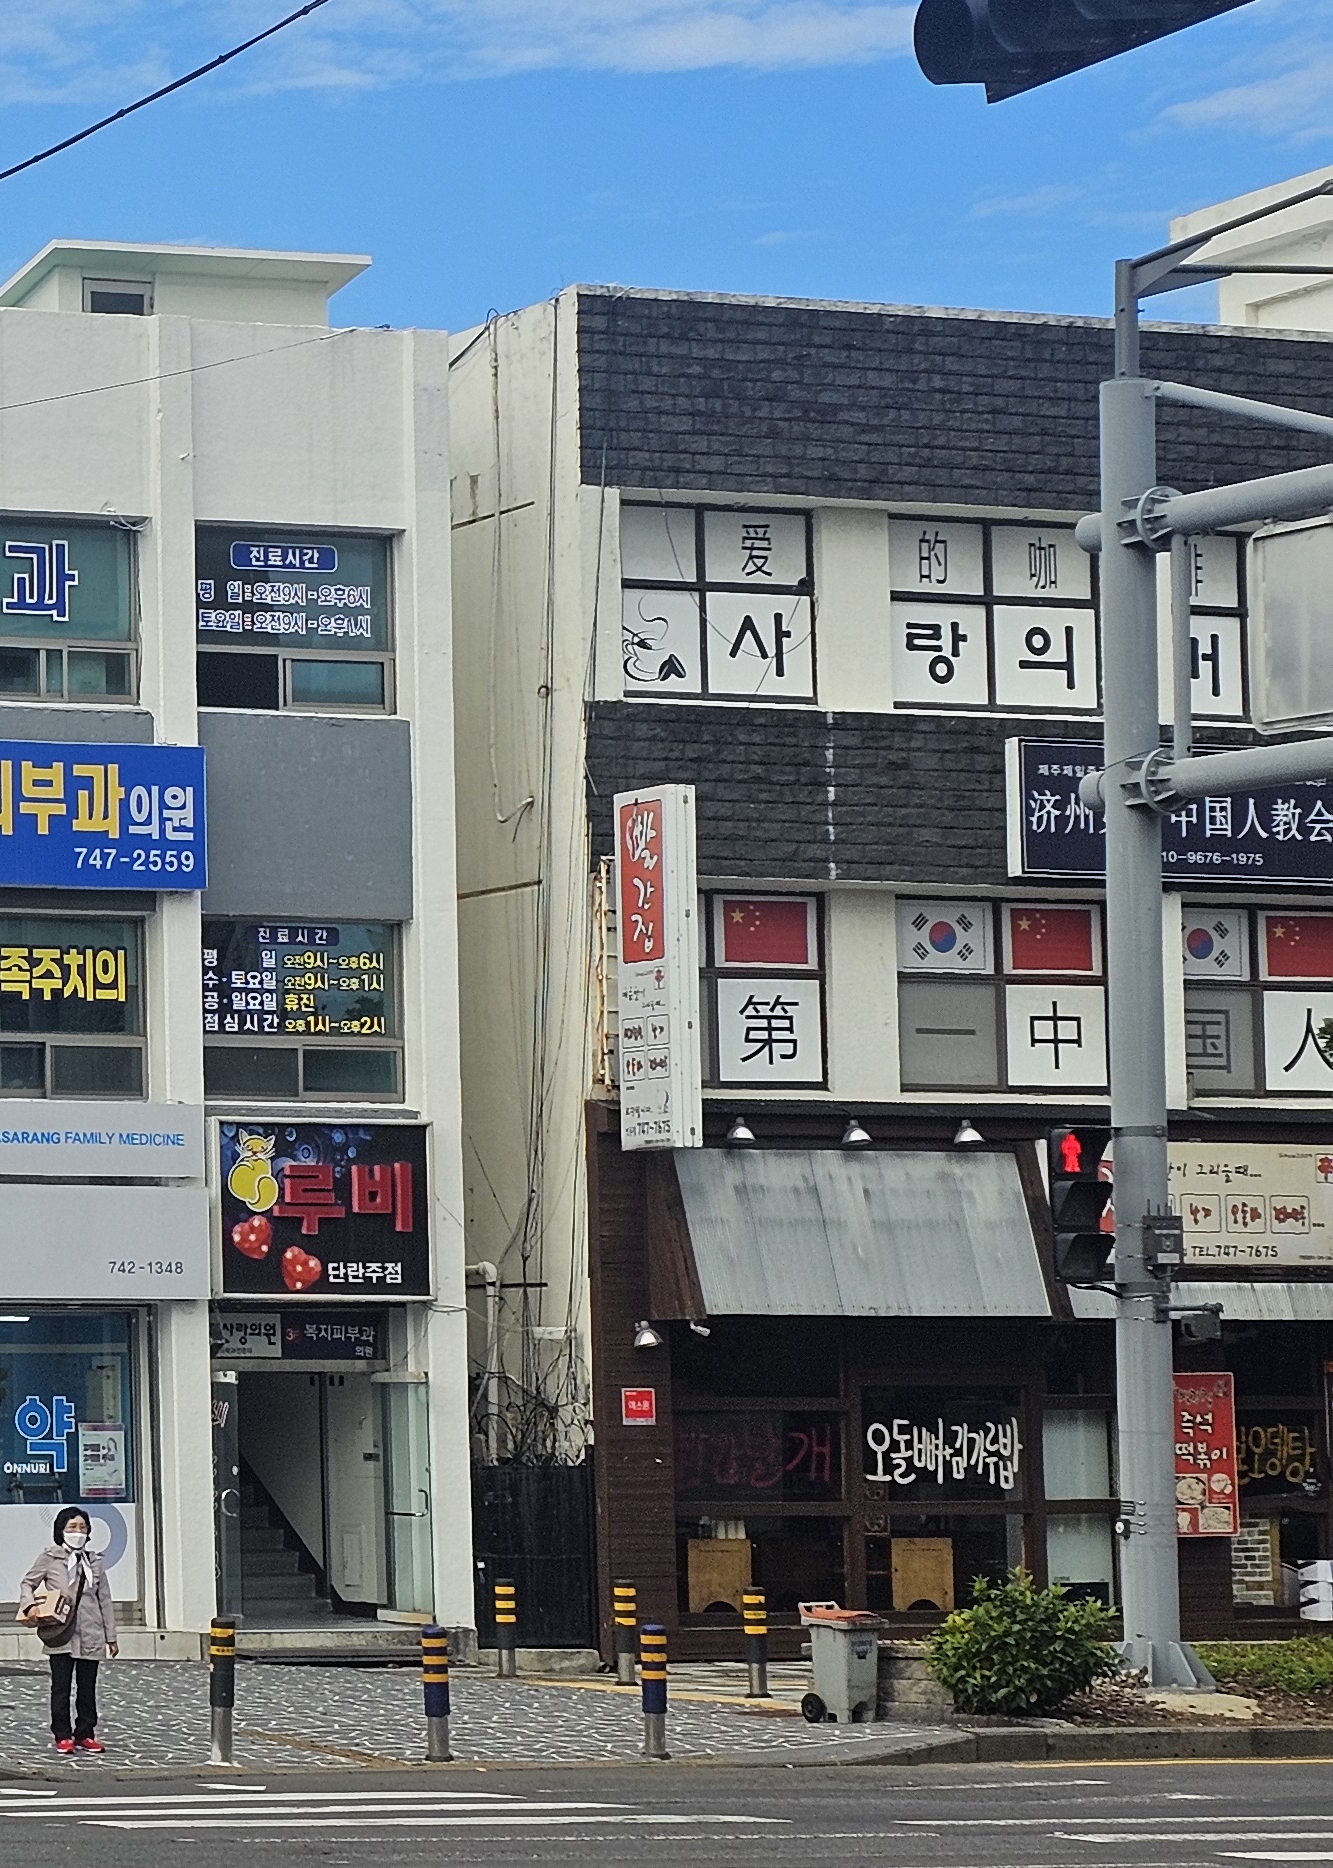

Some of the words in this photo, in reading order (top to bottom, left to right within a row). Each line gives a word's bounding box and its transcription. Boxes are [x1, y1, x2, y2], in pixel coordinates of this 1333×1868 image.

[250, 547, 319, 567] 진료시간
[74, 847, 195, 872] 747-2559
[1161, 851, 1264, 866] 10-9676-1975
[257, 927, 328, 945] 진료시간
[285, 993, 316, 1012] 휴진
[204, 1014, 279, 1032] 점심시간
[65, 1131, 115, 1146] FAMILY
[119, 1132, 185, 1147] MEDICINE
[273, 1162, 413, 1234] 루비
[109, 1261, 184, 1275] 742-1348
[327, 1262, 402, 1284] 단란주점
[304, 1323, 376, 1342] 복지피부과
[355, 1345, 374, 1358] 의원
[15, 1396, 75, 1473] 약
[3, 1461, 50, 1474] ONNURI
